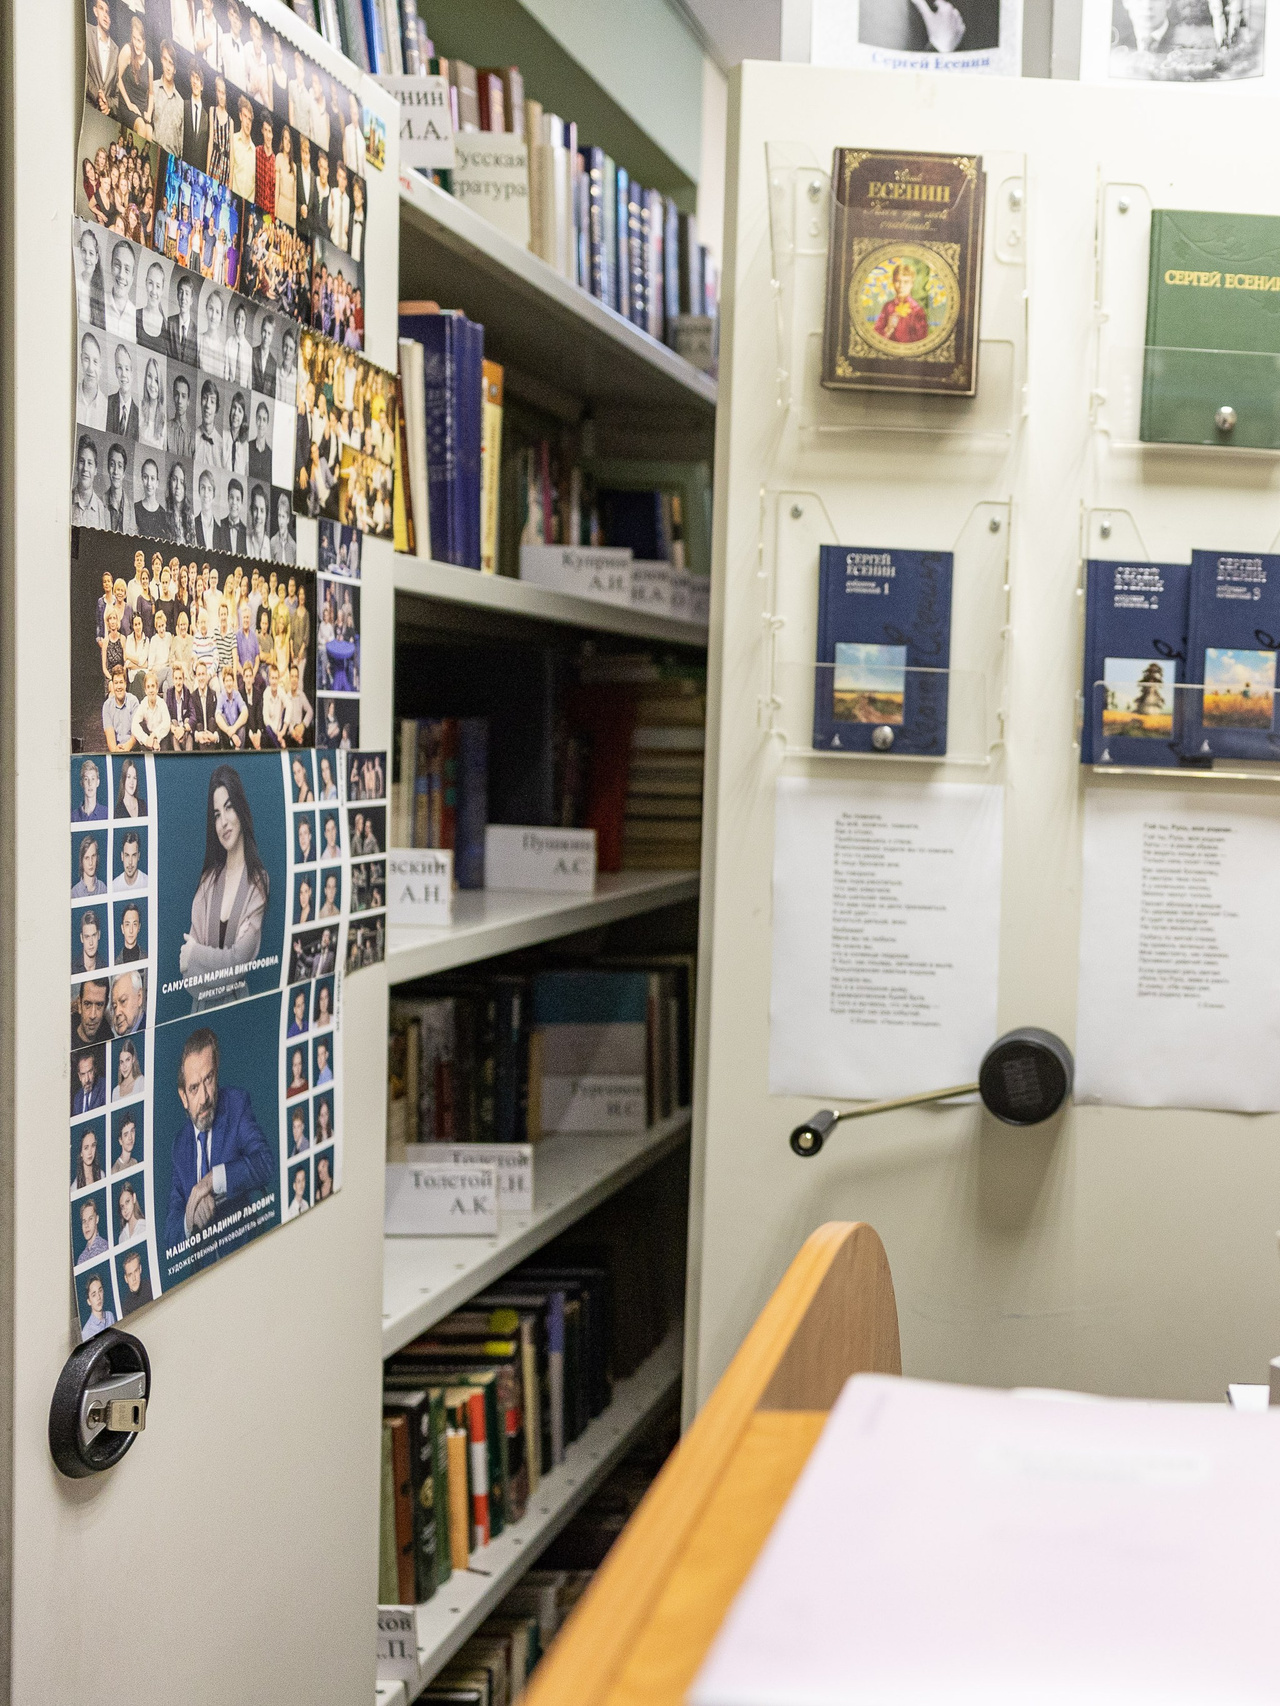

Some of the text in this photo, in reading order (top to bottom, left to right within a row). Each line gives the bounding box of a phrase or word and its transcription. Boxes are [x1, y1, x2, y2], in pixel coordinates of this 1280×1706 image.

[934, 56, 991, 70] Есенин
[455, 147, 526, 170] усская
[867, 181, 951, 203] ЕСЕНИН
[1164, 269, 1222, 288] СЕРГЕЙ
[846, 552, 892, 566] СЕРГЕЙ
[846, 565, 896, 579] ЕСЕНИН
[162, 955, 279, 994] САМУСЕВА МАРИНА ВИКТОРОВНА
[198, 980, 247, 1000] ДИРЕКТОР ШКОЛЫ
[411, 1169, 494, 1189] Толстой
[165, 1193, 276, 1260] МАШКОВ ВЛАДИМИР ЛЬВОВИЧ
[167, 1210, 276, 1276] ХУДОЖЕСТВЕННЫЙ РУКОВОДИТЕЛЬ ШКОЛЫ
